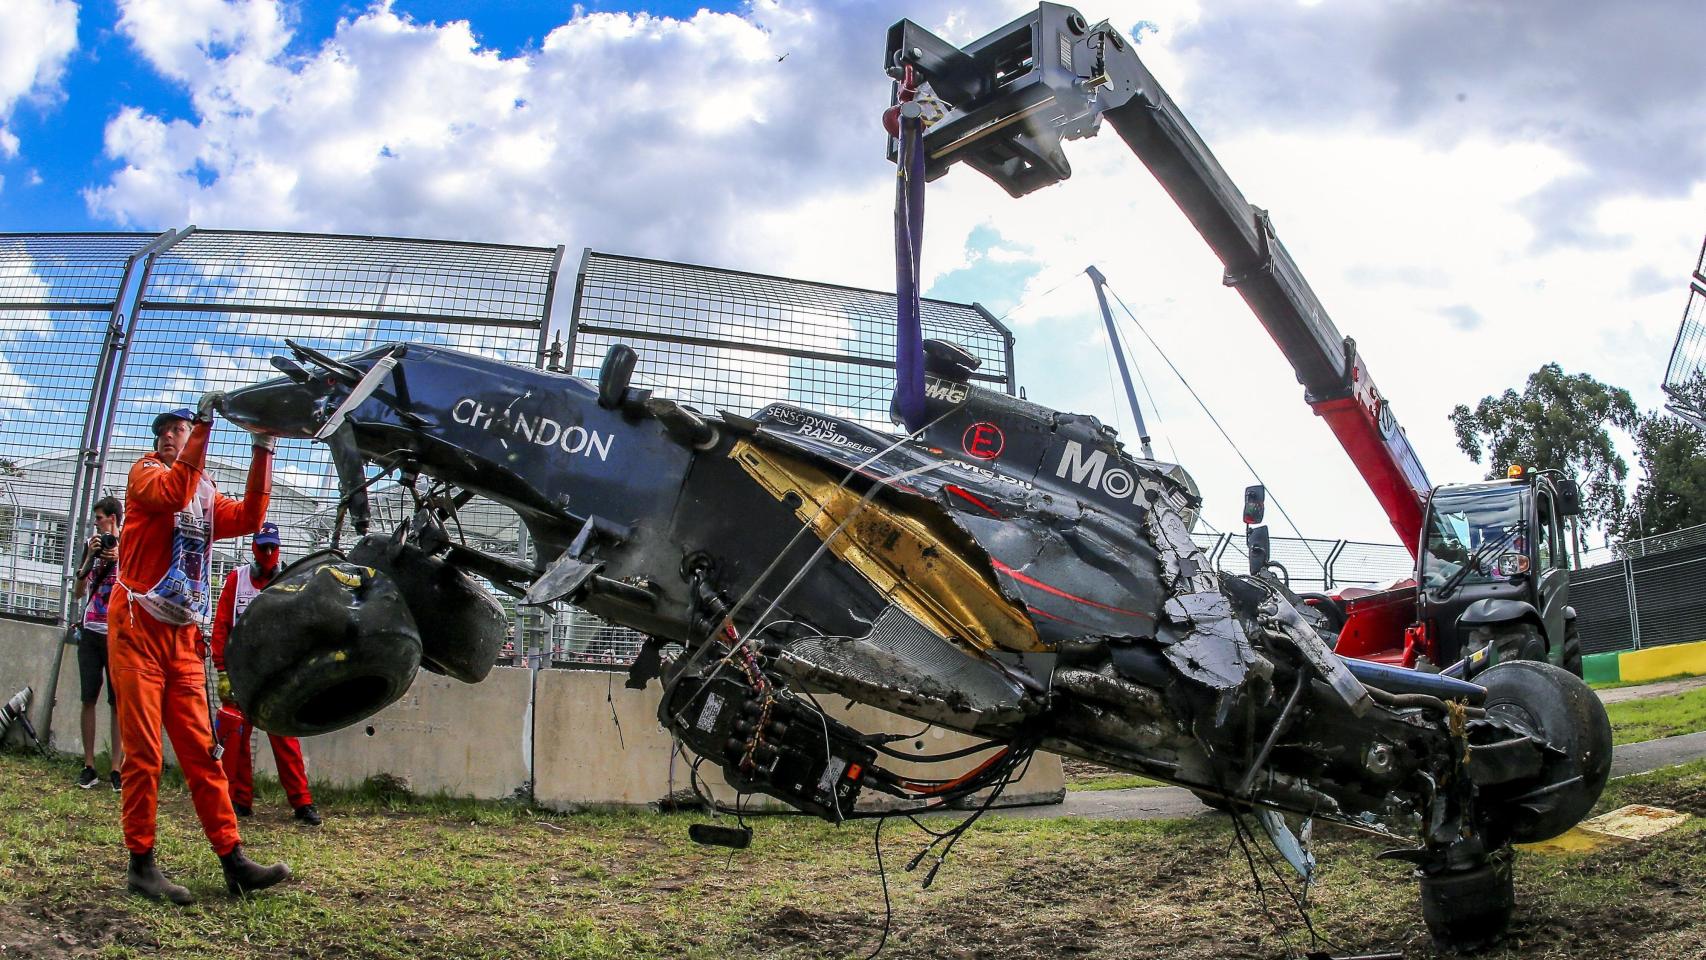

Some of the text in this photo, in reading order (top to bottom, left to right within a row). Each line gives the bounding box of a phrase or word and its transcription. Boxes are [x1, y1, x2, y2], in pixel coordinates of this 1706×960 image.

[766, 406, 839, 433] SENSODYNE
[798, 424, 878, 455] RAPID RELIEF
